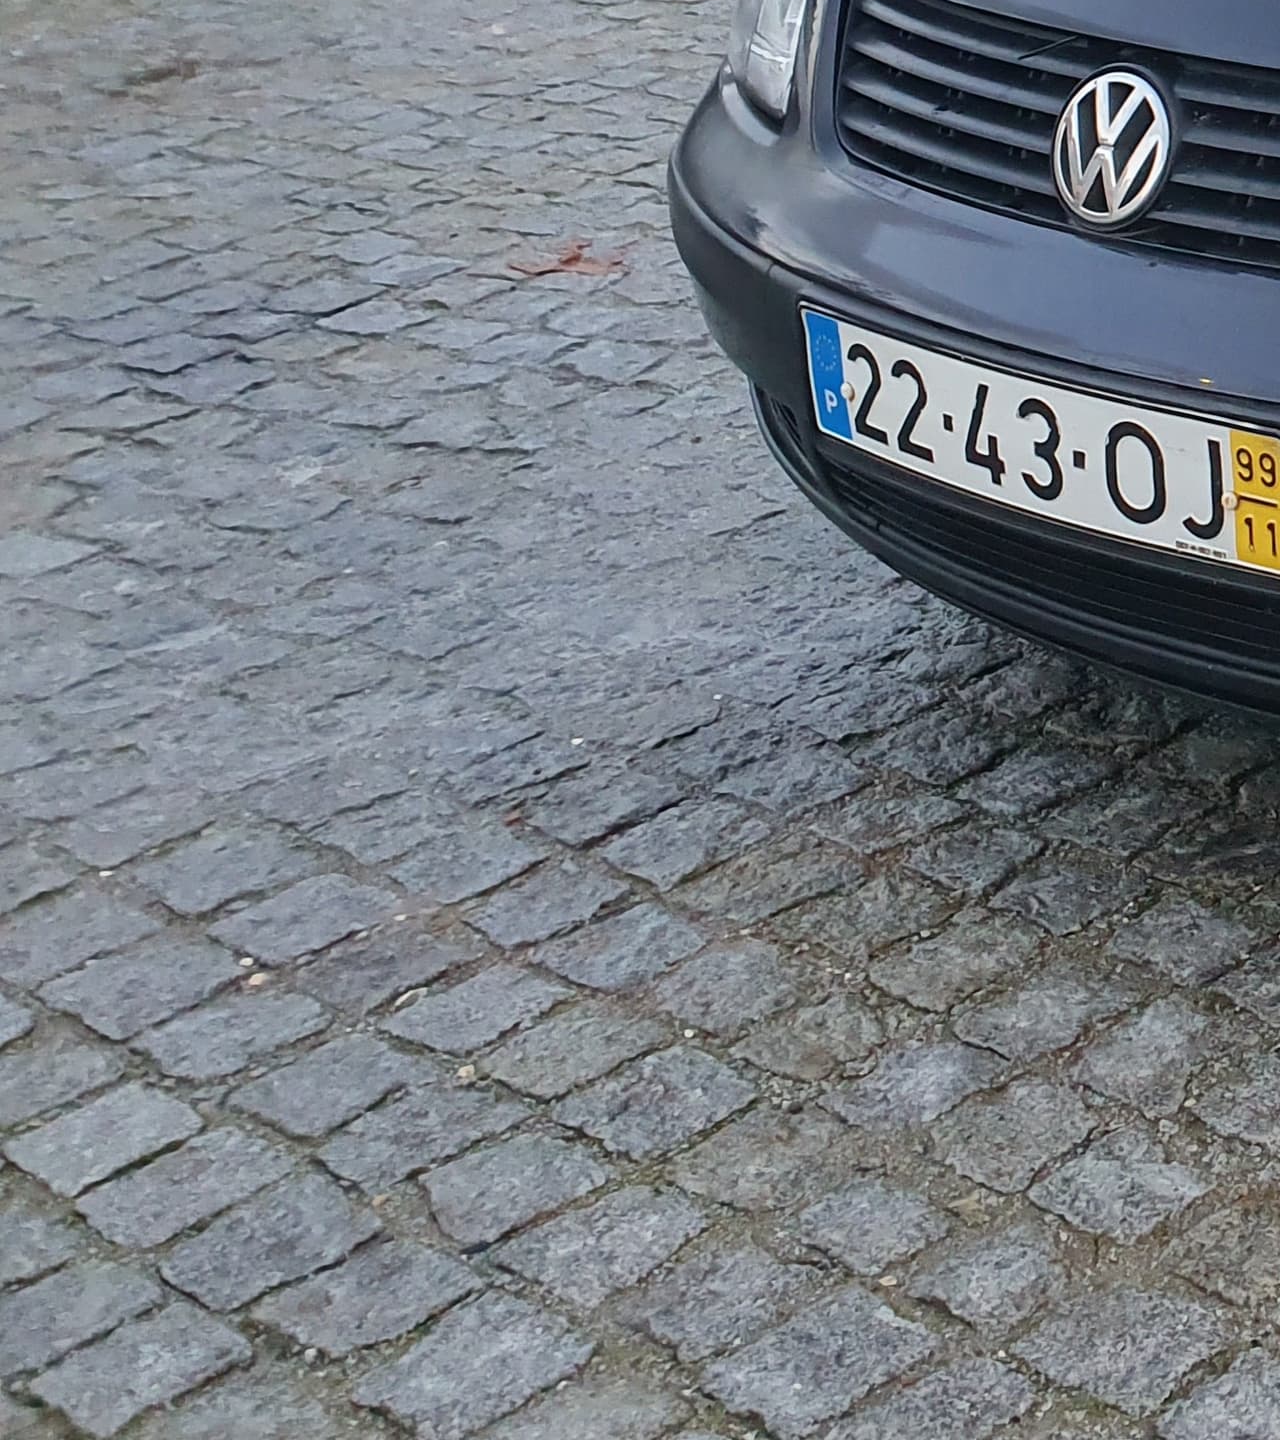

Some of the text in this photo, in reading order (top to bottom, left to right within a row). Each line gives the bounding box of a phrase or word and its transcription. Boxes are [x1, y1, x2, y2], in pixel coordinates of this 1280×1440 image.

[824, 388, 838, 414] P
[1236, 447, 1278, 488] 99
[1243, 516, 1278, 558] 11
